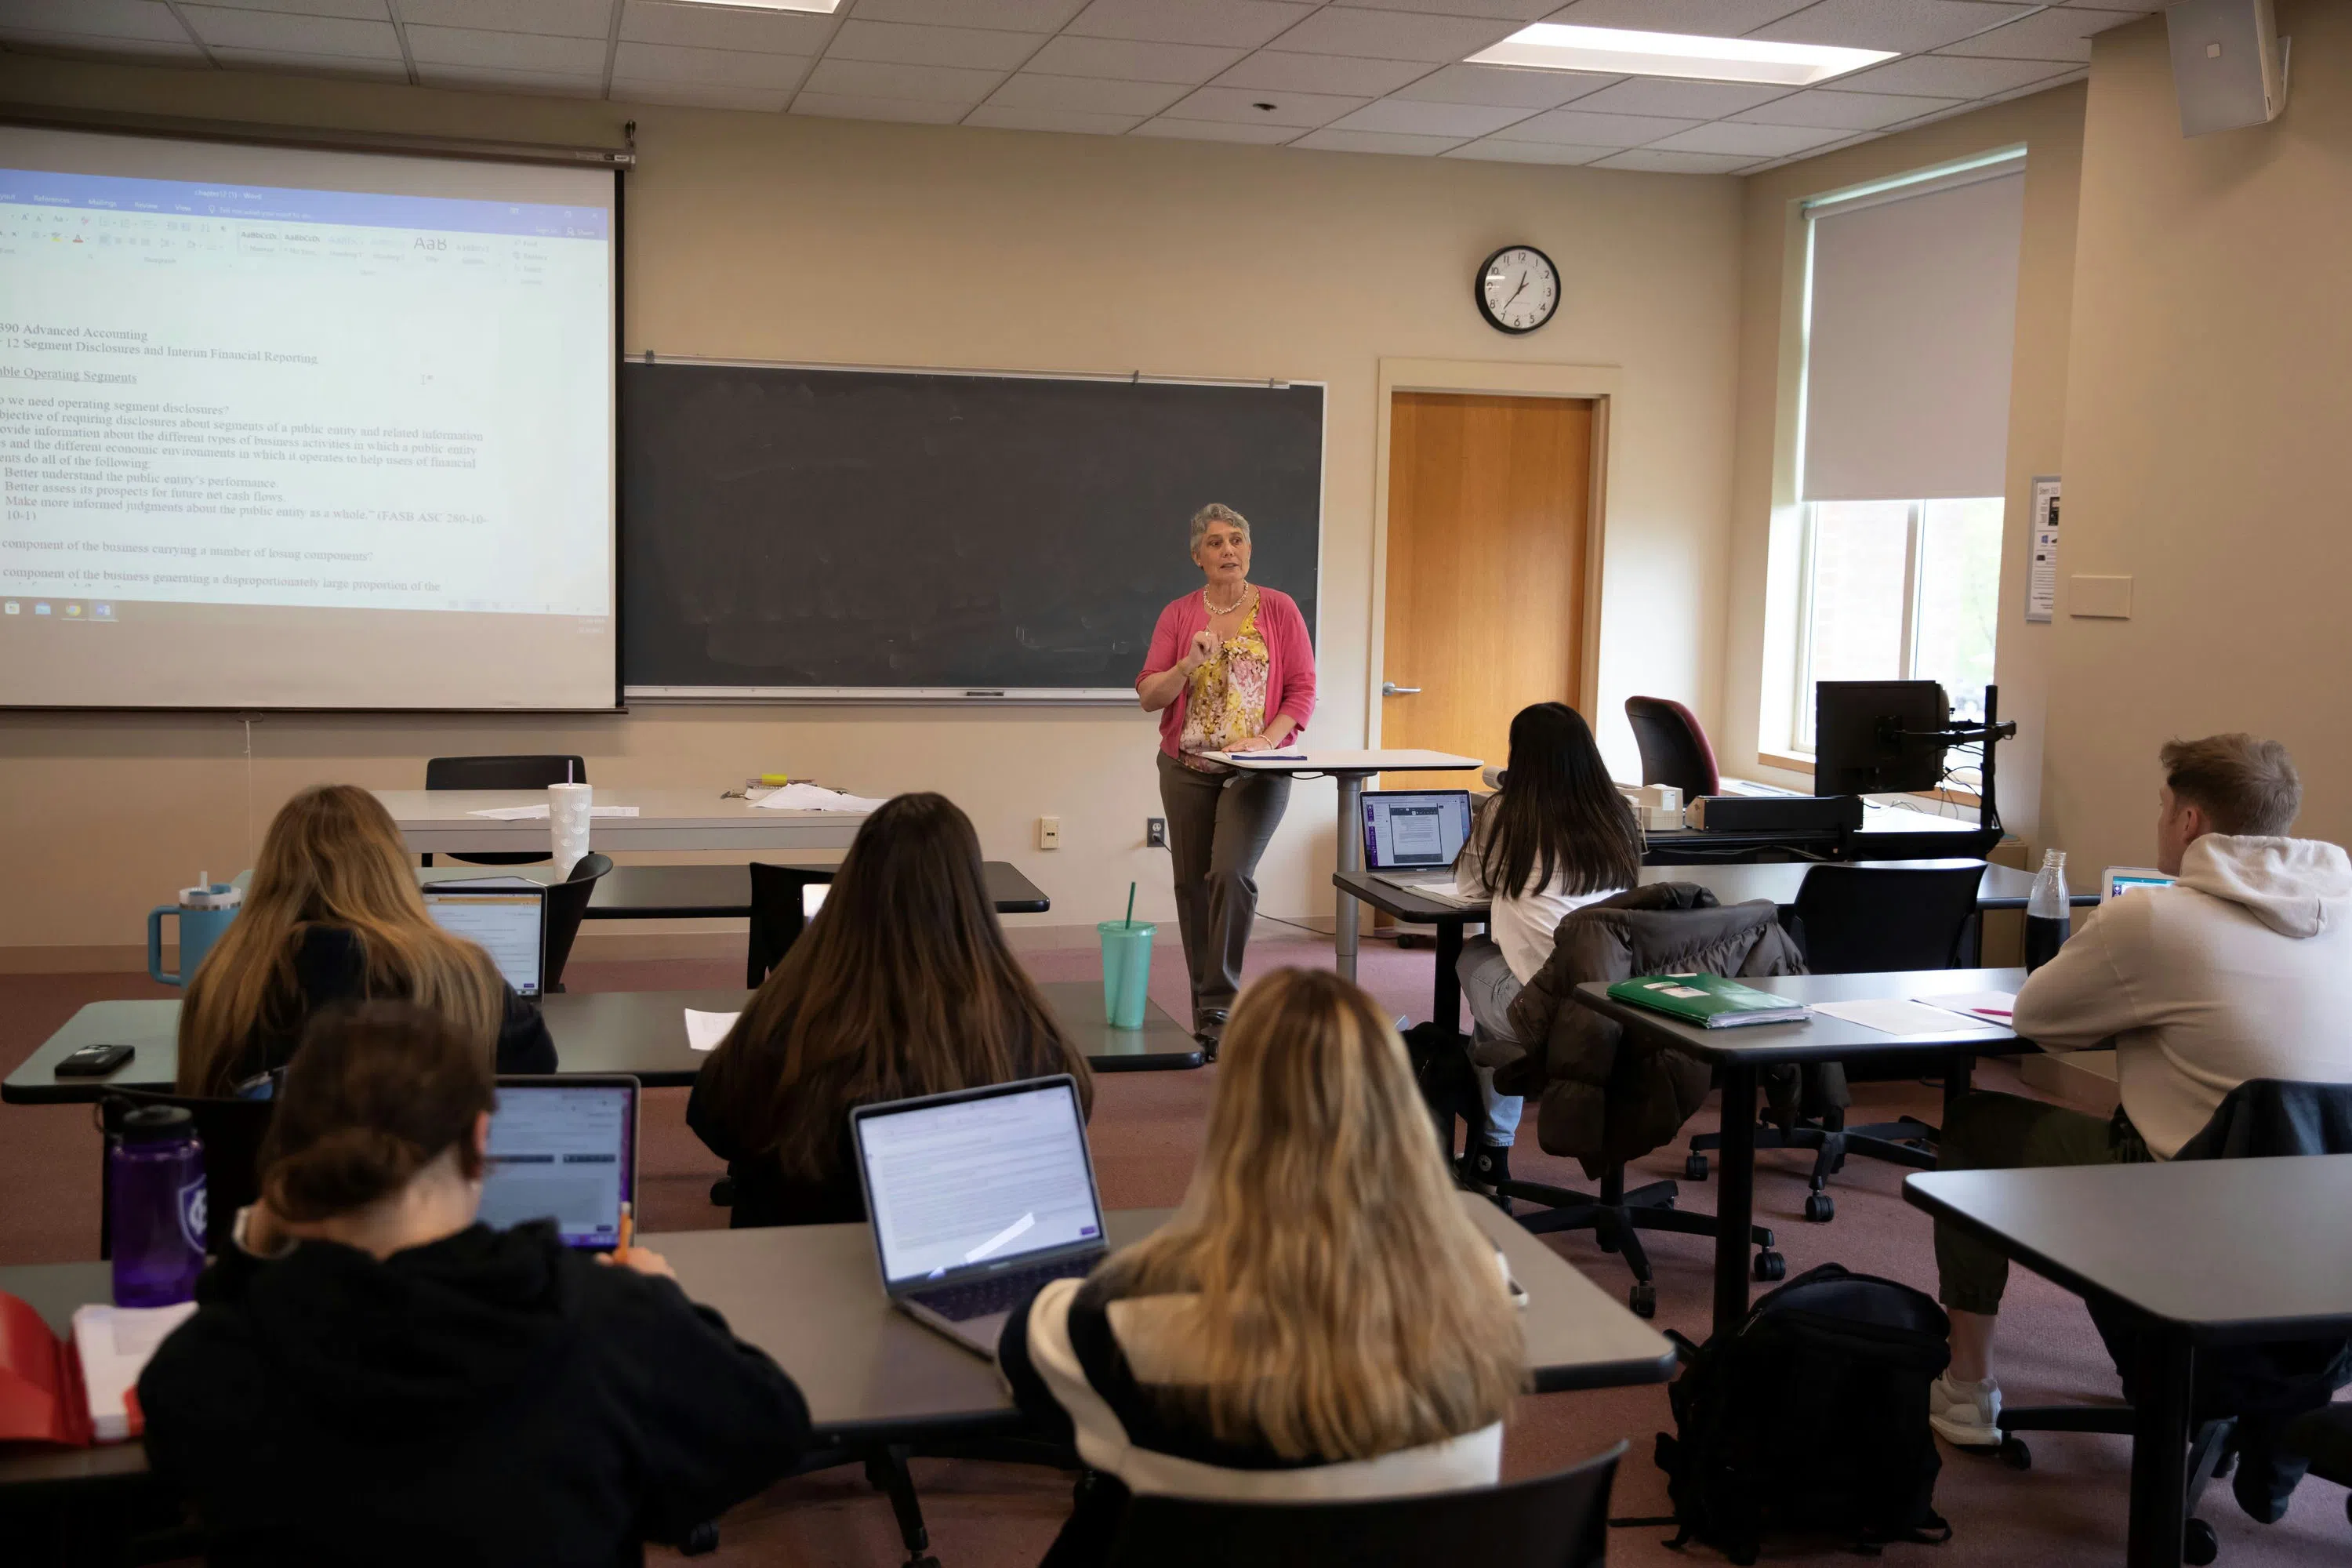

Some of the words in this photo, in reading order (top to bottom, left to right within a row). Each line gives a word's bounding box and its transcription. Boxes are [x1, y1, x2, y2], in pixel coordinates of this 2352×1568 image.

[1503, 256, 1509, 264] 11
[1518, 252, 1526, 261] 12
[1544, 270, 1550, 279] 2
[1547, 288, 1552, 297] 3
[1490, 299, 1496, 309] 8
[1540, 303, 1546, 311] 4
[1514, 318, 1521, 327] 6
[1530, 315, 1535, 324] 5
[23, 325, 80, 336] Advanced
[82, 328, 148, 343] Accounting
[7, 339, 20, 348] 12
[23, 340, 72, 354] Segment
[75, 342, 141, 354] Disclosures
[143, 345, 164, 355] and
[167, 347, 208, 358] Interim
[209, 349, 261, 360] Financial
[263, 351, 319, 365] Reporting
[23, 368, 79, 382] Operating
[83, 371, 137, 384] Segments
[7, 397, 25, 405] we
[27, 397, 55, 407] need
[57, 398, 111, 412] operating
[113, 401, 159, 414] segment
[46, 412, 60, 422] of
[61, 414, 113, 427] requiring
[115, 416, 177, 426] disclosures
[180, 419, 211, 428] about
[213, 421, 264, 434] segments
[267, 423, 280, 431] of
[290, 423, 324, 436] public
[326, 426, 358, 437] entity
[360, 426, 380, 436] and
[383, 427, 419, 438] related
[419, 430, 484, 441] information
[0, 424, 31, 435] ovide
[34, 426, 100, 438] information
[103, 429, 134, 440] about
[137, 430, 154, 441] the
[157, 431, 205, 443] different
[207, 434, 238, 446] types
[238, 434, 253, 445] of
[253, 436, 299, 447] business
[302, 438, 351, 449] activities
[366, 441, 400, 452] which
[410, 443, 444, 456] public
[447, 445, 477, 459] entity
[9, 439, 31, 449] and
[34, 440, 51, 450] the
[53, 441, 102, 452] different
[105, 444, 159, 455] economic
[162, 446, 236, 458] environments
[238, 450, 250, 459] in
[252, 449, 286, 460] which
[288, 452, 296, 460] it
[299, 452, 344, 466] operates
[360, 454, 383, 467] help
[416, 456, 429, 466] of
[430, 456, 477, 469] financial
[24, 453, 38, 463] do
[42, 454, 56, 464] all
[59, 456, 73, 465] of
[74, 456, 92, 466] the
[4, 467, 39, 478] Better
[42, 469, 103, 481] understand
[106, 471, 124, 481] the
[126, 473, 161, 485] public
[4, 481, 40, 492] Better
[42, 485, 77, 494] assess
[96, 487, 148, 499] prospects
[151, 487, 168, 497] for
[171, 488, 204, 499] future
[206, 491, 223, 499] net
[225, 491, 250, 501] cash
[5, 495, 38, 506] Make
[40, 499, 70, 508] more
[72, 499, 124, 510] informed
[125, 500, 184, 514] judgments
[186, 503, 216, 514] about
[220, 505, 236, 514] the
[238, 506, 274, 518] public
[275, 508, 307, 519] entity
[417, 514, 443, 523] ASC
[2, 540, 64, 552] component
[67, 541, 81, 550] of
[82, 542, 100, 551] the
[102, 543, 150, 553] business
[151, 545, 198, 557] carrying
[209, 547, 252, 557] number
[253, 548, 267, 557] of
[268, 548, 302, 561] losing
[2, 569, 65, 581] component
[67, 570, 81, 579] of
[82, 570, 100, 579] the
[103, 571, 151, 582] business
[152, 574, 211, 586] generating
[222, 575, 320, 590] disproportionately
[322, 579, 350, 590] large
[352, 580, 408, 592] proportion
[410, 581, 424, 591] of
[423, 582, 441, 591] the
